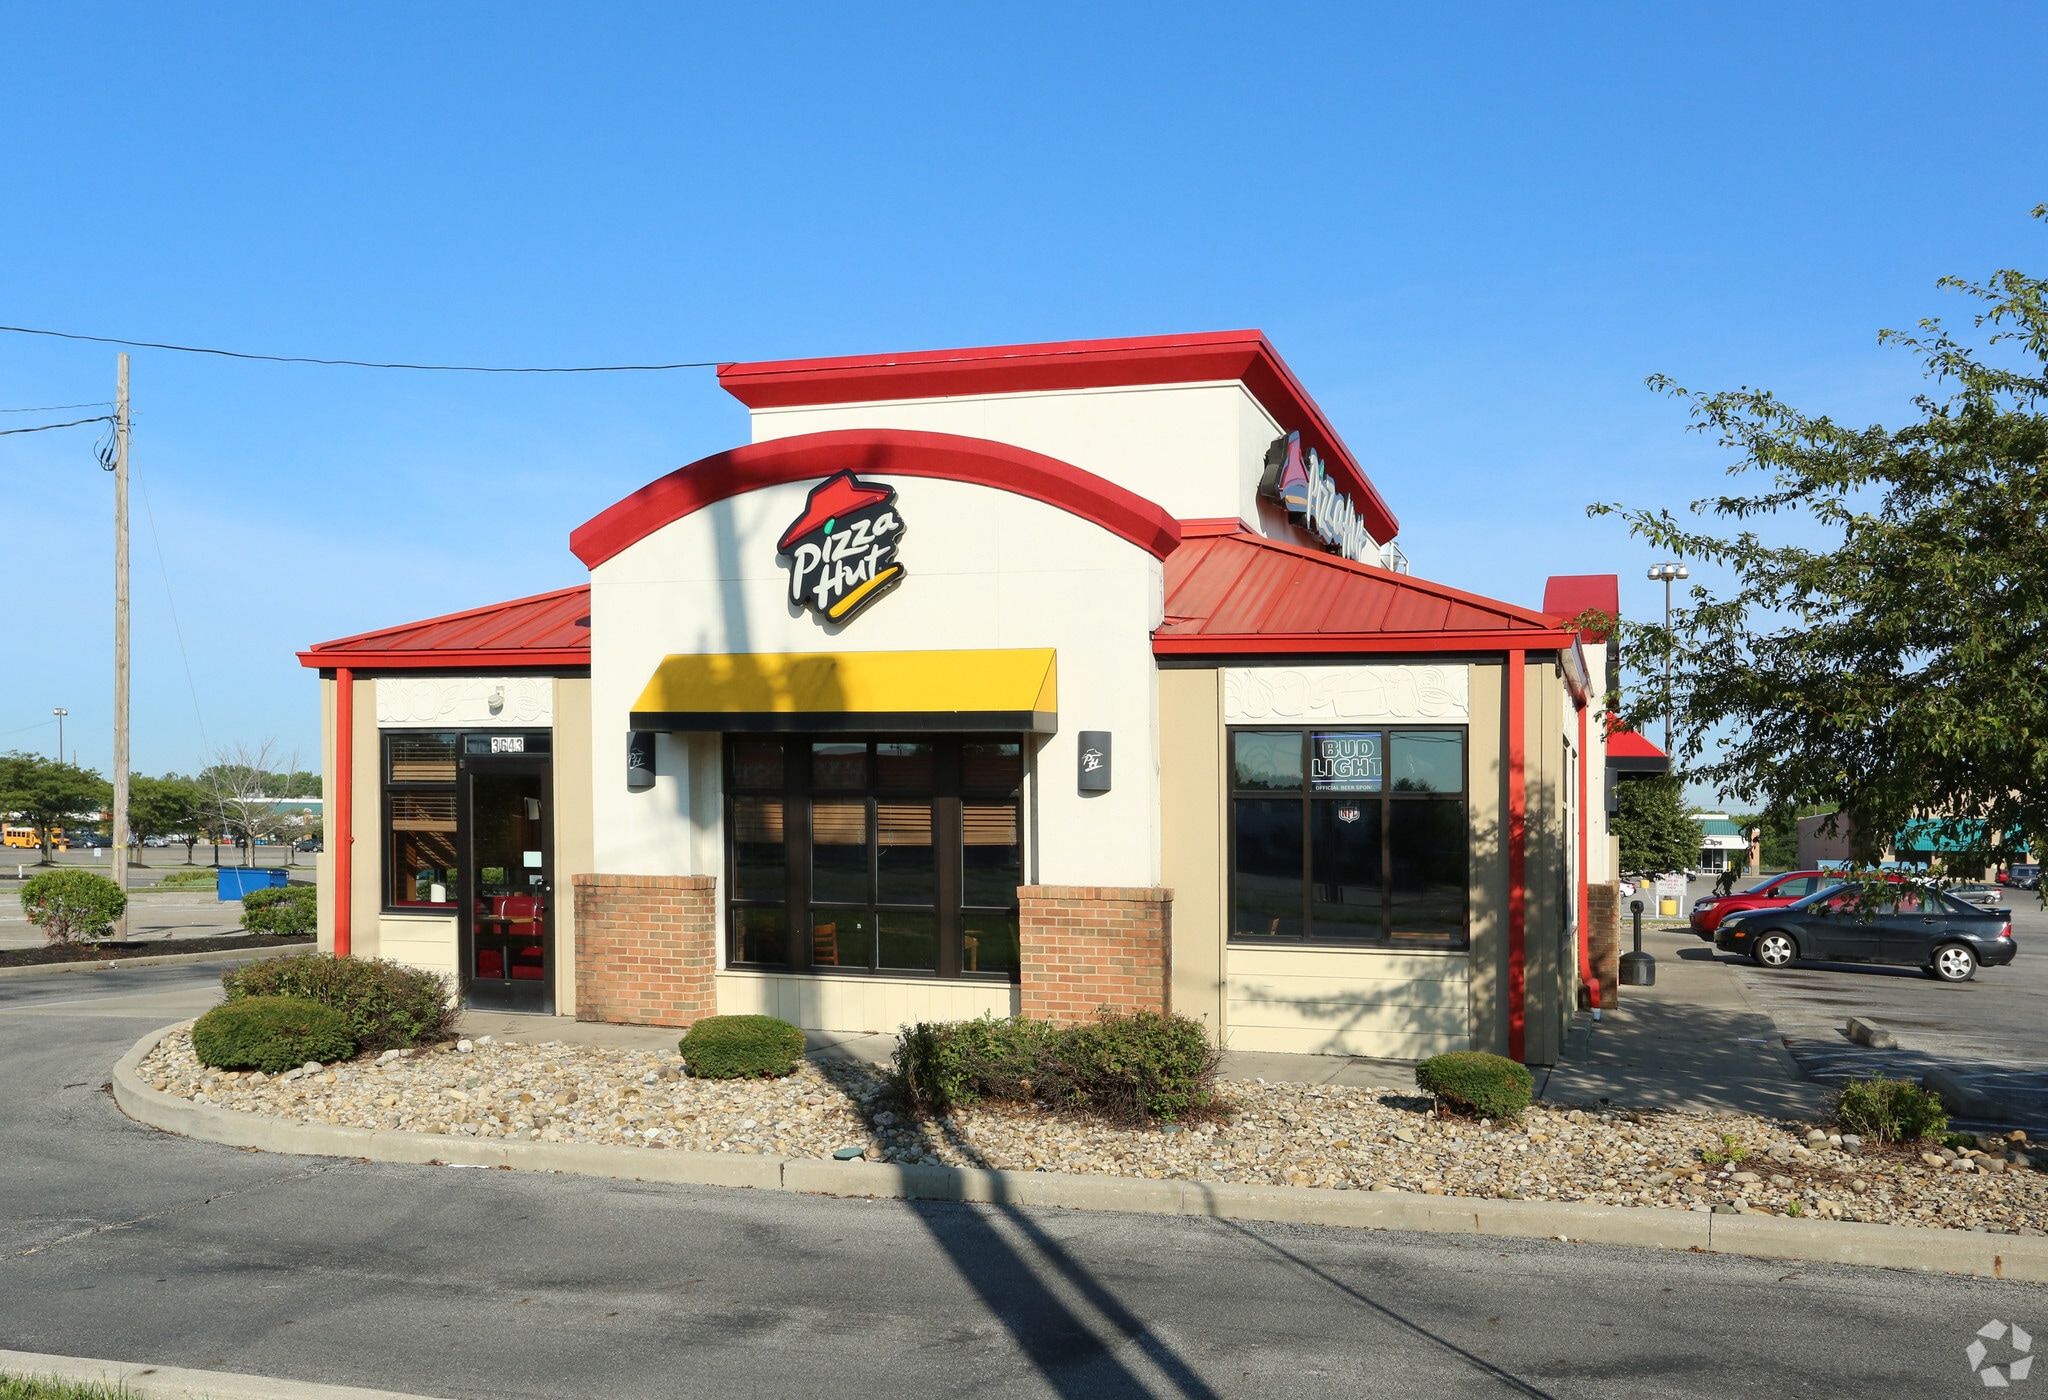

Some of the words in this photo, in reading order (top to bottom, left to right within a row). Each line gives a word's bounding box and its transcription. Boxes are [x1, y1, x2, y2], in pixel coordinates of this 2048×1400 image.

[793, 512, 899, 600] Pizza
[813, 544, 891, 610] Hut
[492, 738, 523, 752] 3643
[1322, 740, 1375, 758] BUD
[1312, 758, 1382, 777] LIGHT
[1341, 807, 1357, 818] NFL
[1703, 838, 1722, 847] Clips
